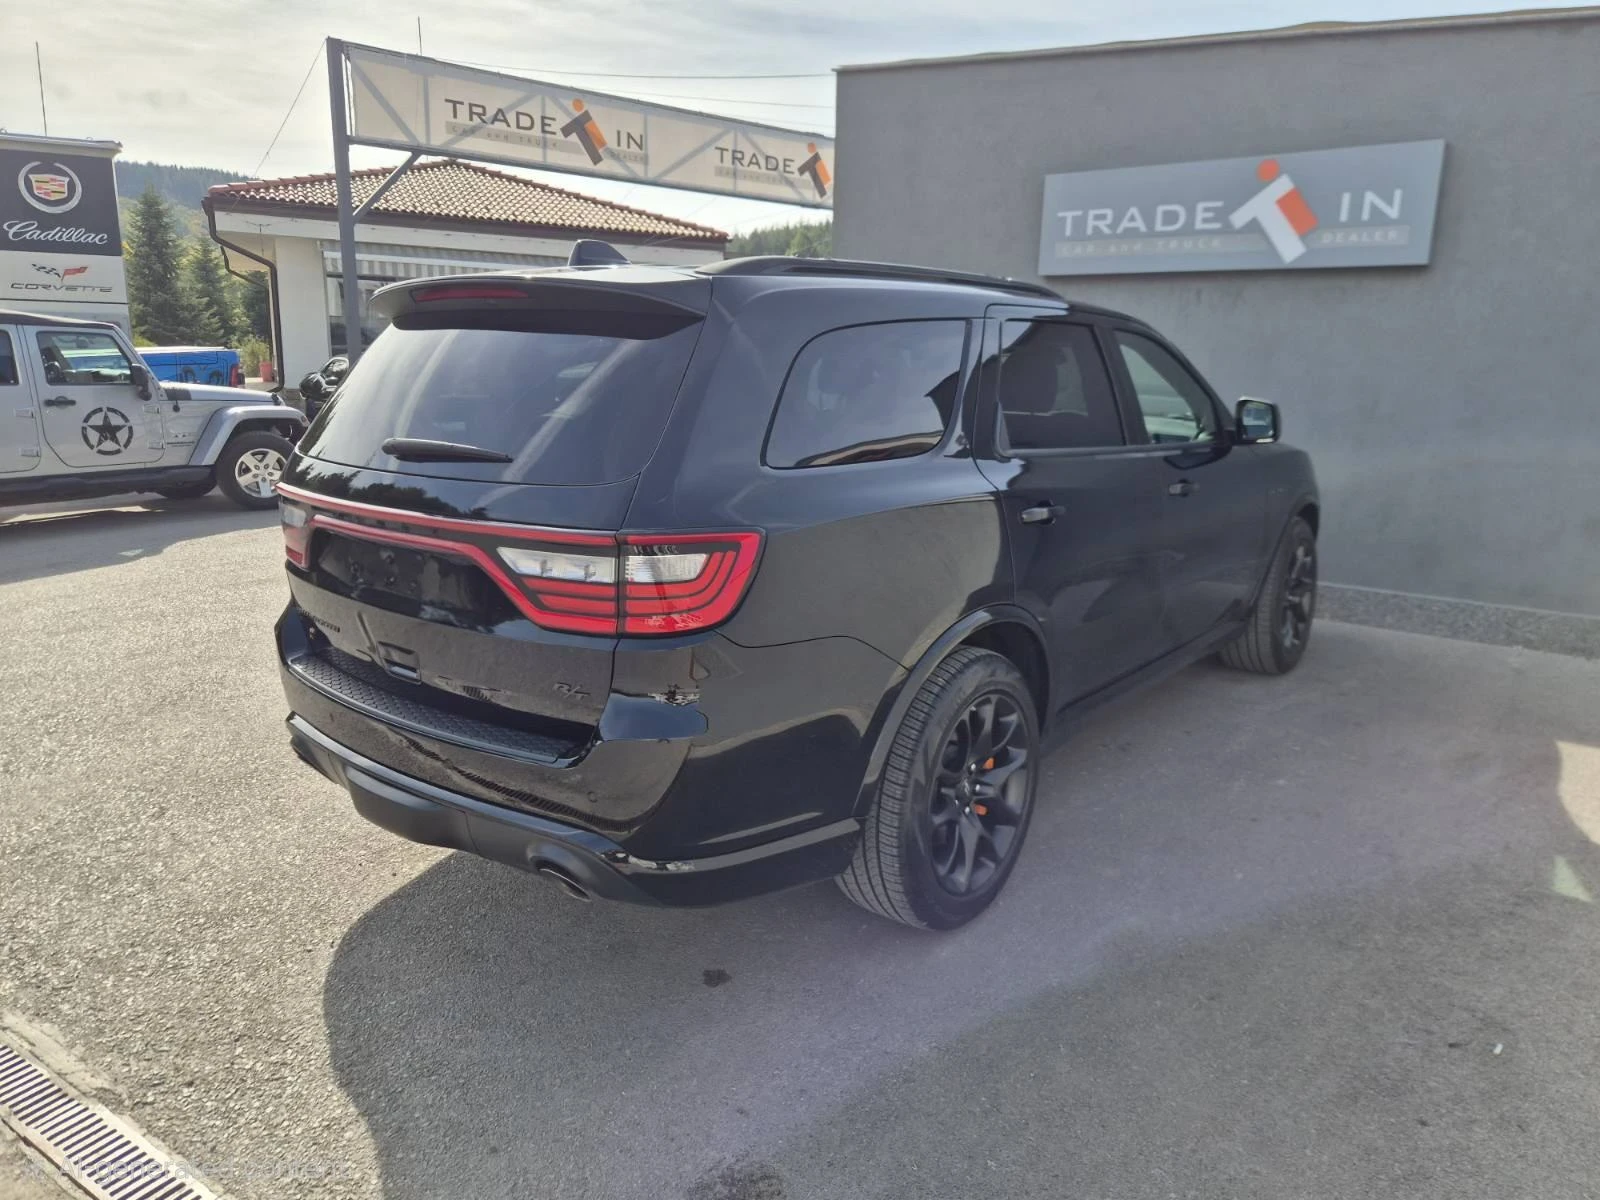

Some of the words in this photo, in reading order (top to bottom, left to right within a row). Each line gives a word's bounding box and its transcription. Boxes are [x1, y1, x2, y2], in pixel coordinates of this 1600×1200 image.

[444, 98, 557, 136] TRADE
[616, 129, 644, 151] IN
[714, 146, 796, 175] TRADE
[1057, 201, 1225, 237] TRADE
[1339, 188, 1404, 222] IN
[3, 220, 108, 245] Cadillac
[1321, 229, 1398, 244] DEALER
[10, 281, 113, 293] CORVETTE
